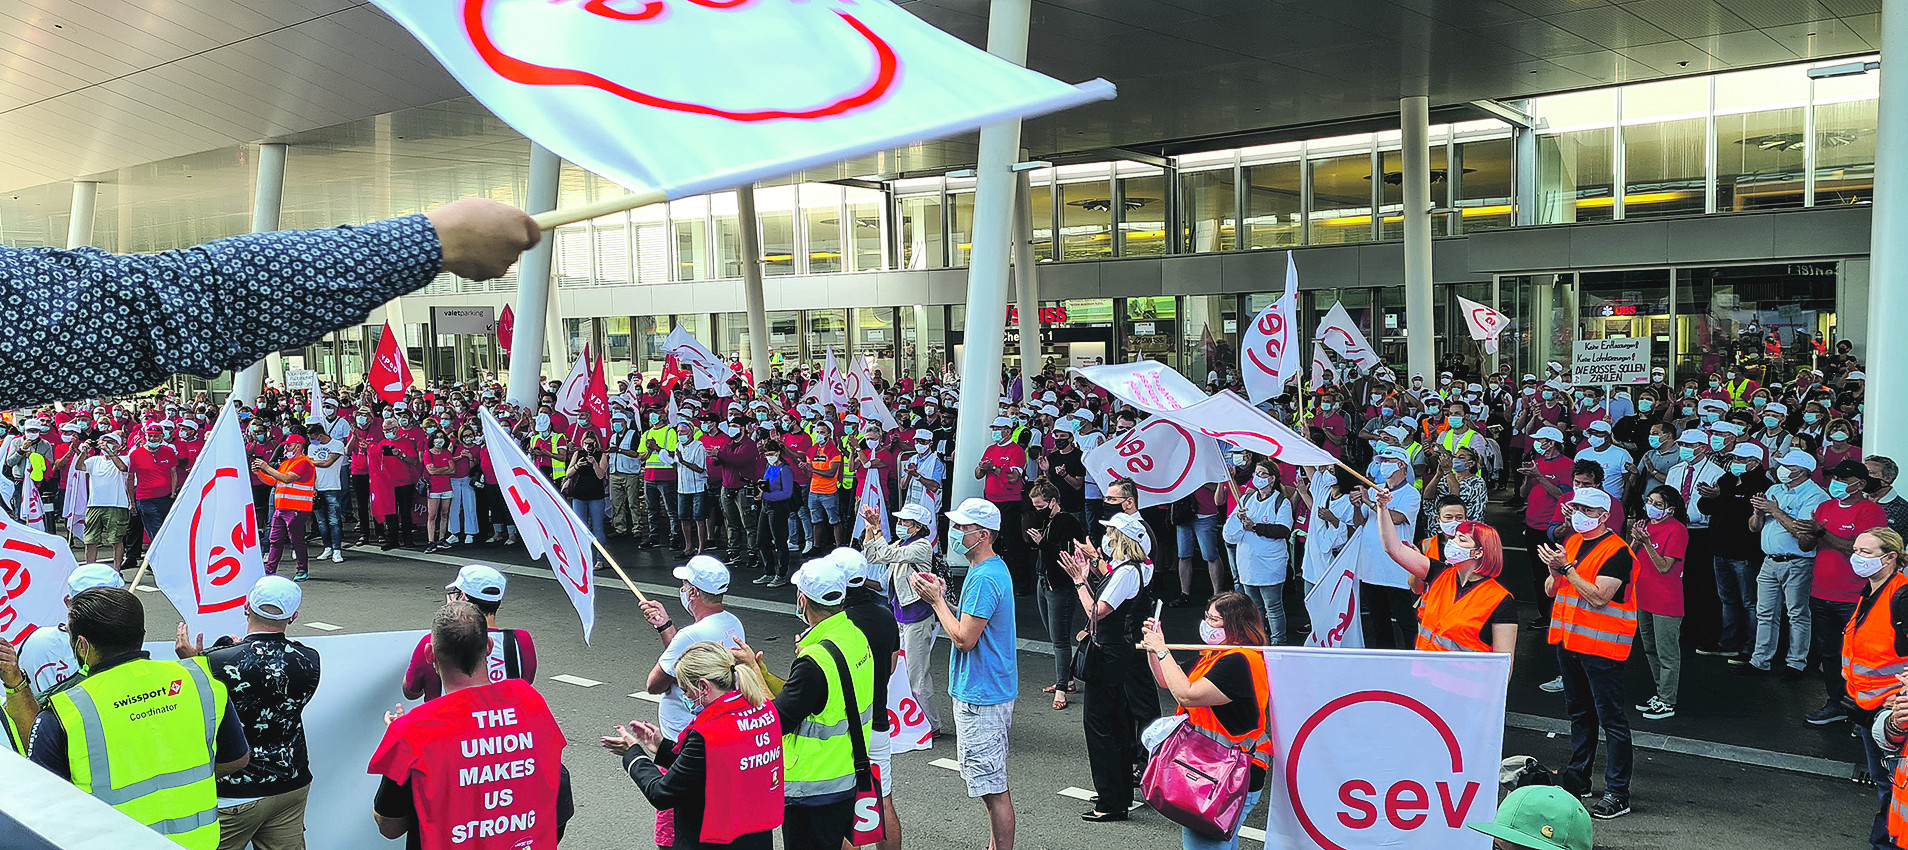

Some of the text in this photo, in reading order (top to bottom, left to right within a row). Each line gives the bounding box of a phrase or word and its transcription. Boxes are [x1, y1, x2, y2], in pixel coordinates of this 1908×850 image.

[443, 309, 484, 318] valetparking
[1613, 305, 1637, 316] UBS
[1047, 330, 1053, 341] 1
[1575, 363, 1647, 375] DIE BOSSE SOLLEN
[1589, 373, 1623, 383] ZAHLEN
[113, 686, 168, 709] swissport
[129, 703, 178, 723] Coordinator
[472, 707, 518, 729] THE
[461, 731, 534, 759] UNION
[755, 731, 771, 748] US
[739, 745, 781, 771] STRONG
[459, 757, 535, 787] MAKES
[484, 788, 514, 811] US
[1336, 778, 1481, 831] sev
[451, 809, 536, 845] STRONG
